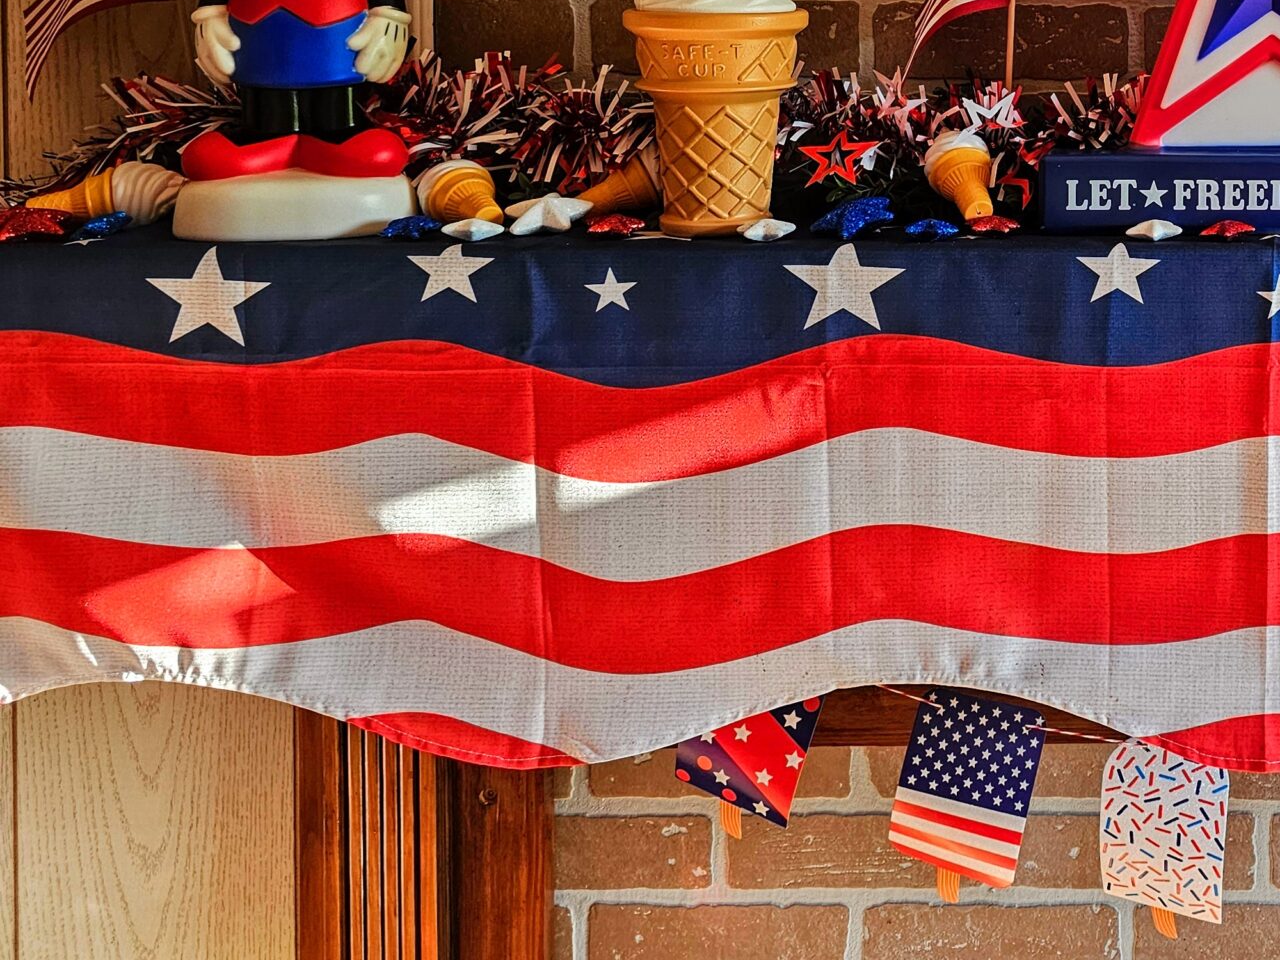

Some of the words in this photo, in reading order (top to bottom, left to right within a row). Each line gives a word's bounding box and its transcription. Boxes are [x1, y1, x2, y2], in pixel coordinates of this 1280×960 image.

[661, 43, 744, 61] SAFE-T
[678, 63, 726, 78] CUP
[1065, 179, 1138, 211] LET
